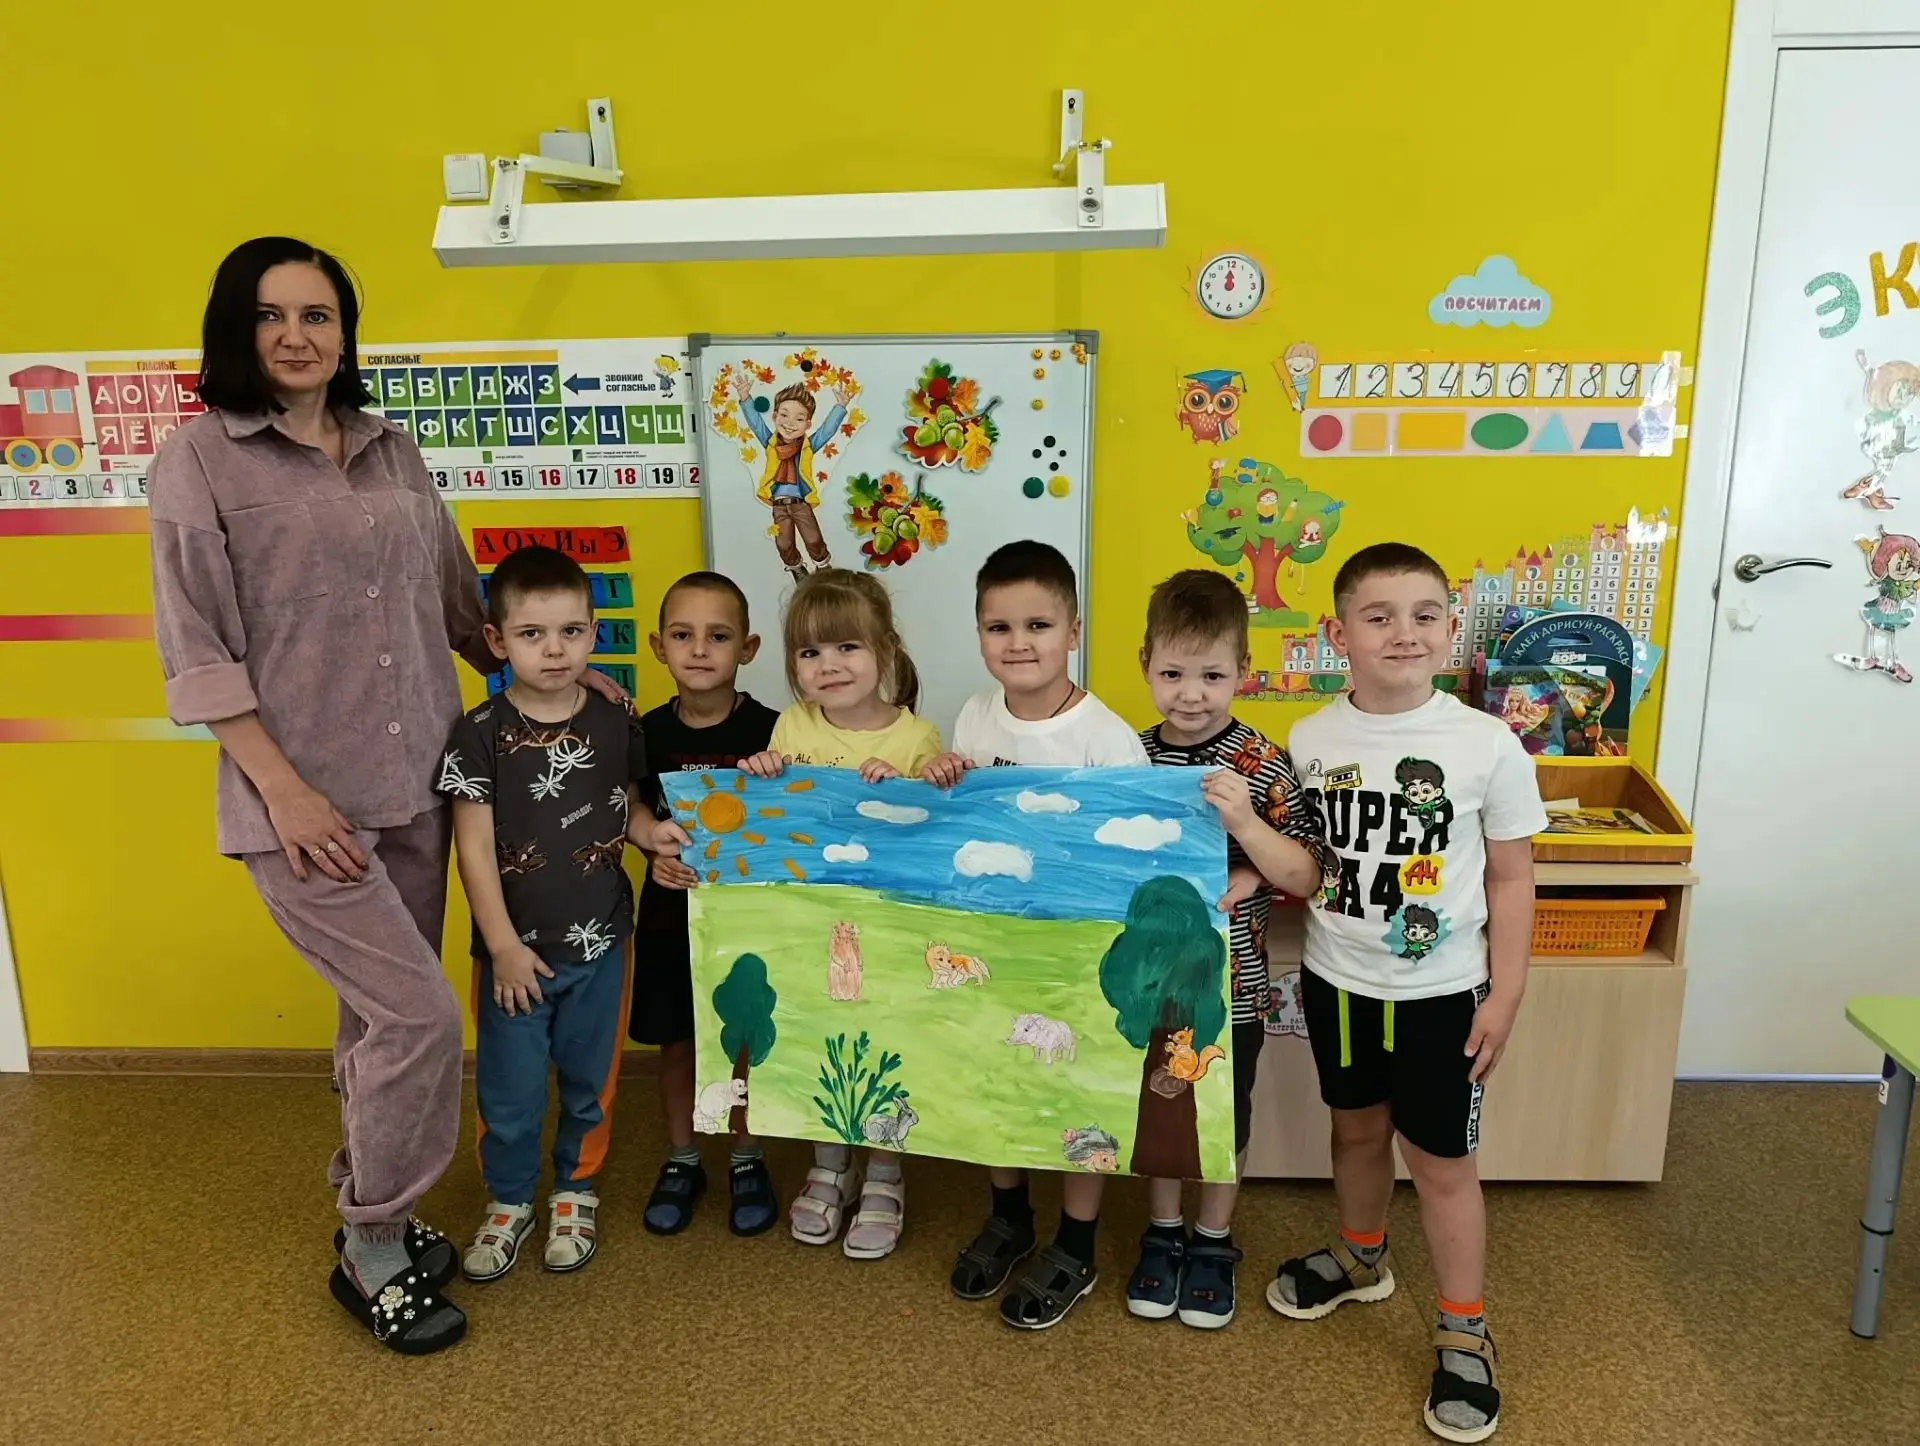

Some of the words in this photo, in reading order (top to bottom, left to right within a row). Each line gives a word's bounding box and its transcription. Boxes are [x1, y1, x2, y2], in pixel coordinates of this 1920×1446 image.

[1804, 242, 1920, 339] ЭК
[1444, 296, 1542, 312] ПОСЧИТАЕМ
[367, 354, 421, 366] СОГЛАСНЫЕ
[387, 377, 407, 398] Б
[417, 377, 436, 397] В
[448, 376, 463, 396] Г
[476, 375, 498, 400] Д
[503, 375, 530, 395] Ж
[538, 374, 555, 395] З
[1335, 363, 1353, 398] 1
[1365, 364, 1388, 398] 2
[1398, 362, 1426, 398] 3
[1438, 361, 1462, 398] 4
[1470, 361, 1496, 398] 5
[1508, 362, 1529, 398] 6
[1547, 362, 1569, 398] 7
[1579, 362, 1604, 398] 8
[1615, 362, 1639, 398] 9
[94, 384, 115, 405] А
[121, 384, 142, 405] О
[151, 383, 169, 404] У
[101, 425, 120, 445] Я
[130, 420, 147, 445] Ё
[419, 418, 442, 438] Ф
[451, 417, 468, 438] К
[480, 416, 498, 436] Т
[506, 416, 533, 436] Ш
[540, 415, 559, 436] С
[570, 415, 591, 435] Х
[600, 414, 620, 438] Ц
[631, 414, 649, 434] Ч
[657, 414, 684, 437] Щ
[28, 479, 42, 496] 2
[65, 478, 78, 496] 3
[102, 478, 114, 494] 4
[463, 470, 486, 487] 14
[501, 469, 524, 487] 15
[538, 468, 561, 486] 16
[576, 468, 599, 486] 17
[613, 467, 636, 485] 18
[651, 467, 674, 485] 19
[689, 466, 700, 484] 2
[1511, 632, 1540, 663] АКЛЕЙ
[1541, 619, 1592, 638] ДОРИСУЙ
[1594, 623, 1630, 665] РАСКРАСЬ
[794, 753, 812, 764] ALL
[1304, 788, 1454, 856] SUPER
[1404, 859, 1438, 887] A4
[1471, 1096, 1481, 1115] BE
